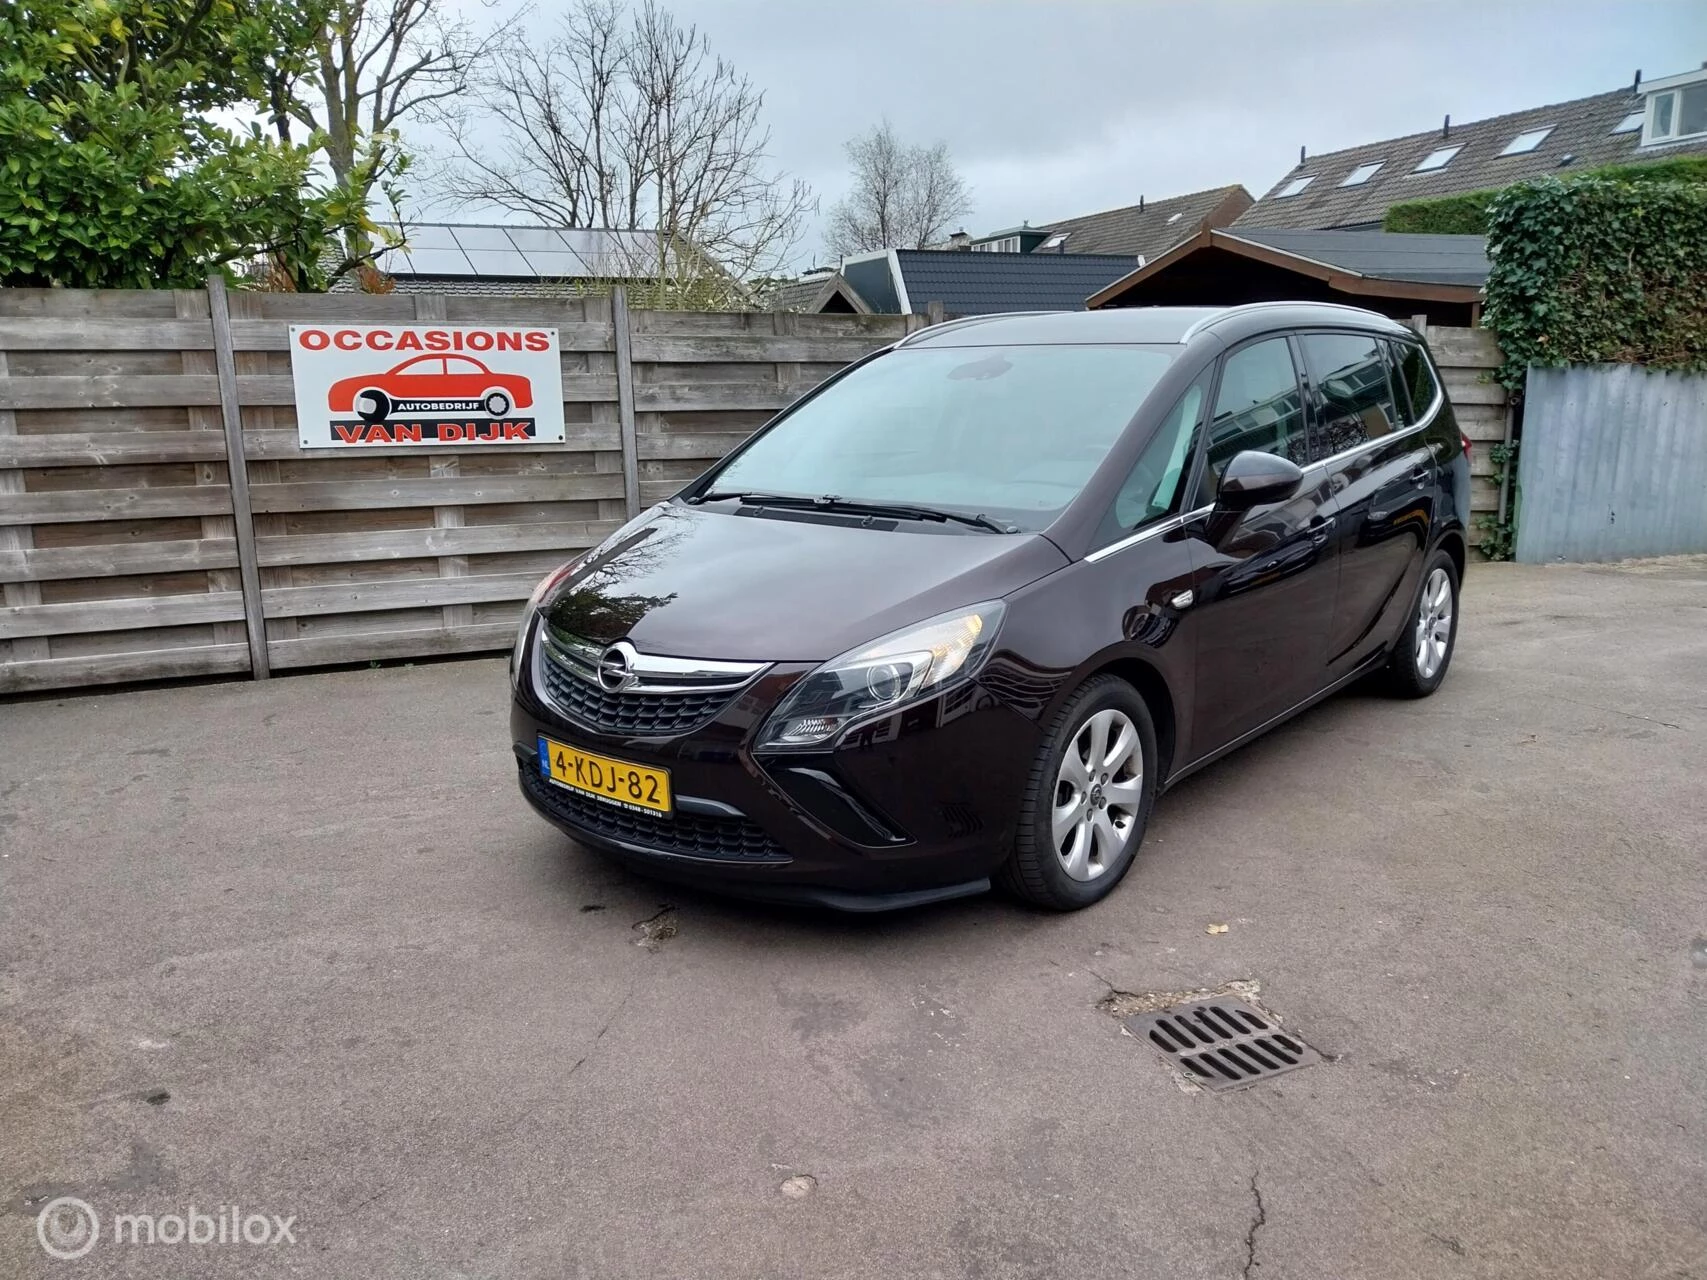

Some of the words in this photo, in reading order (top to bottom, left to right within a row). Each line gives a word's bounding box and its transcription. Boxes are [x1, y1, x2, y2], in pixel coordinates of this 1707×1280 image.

[298, 329, 550, 352] OCCASIONS
[397, 400, 480, 411] AUTOBEDRIJF
[334, 422, 423, 444] VAN
[437, 421, 531, 442] DIJK
[555, 750, 661, 805] 4-KDJ-82
